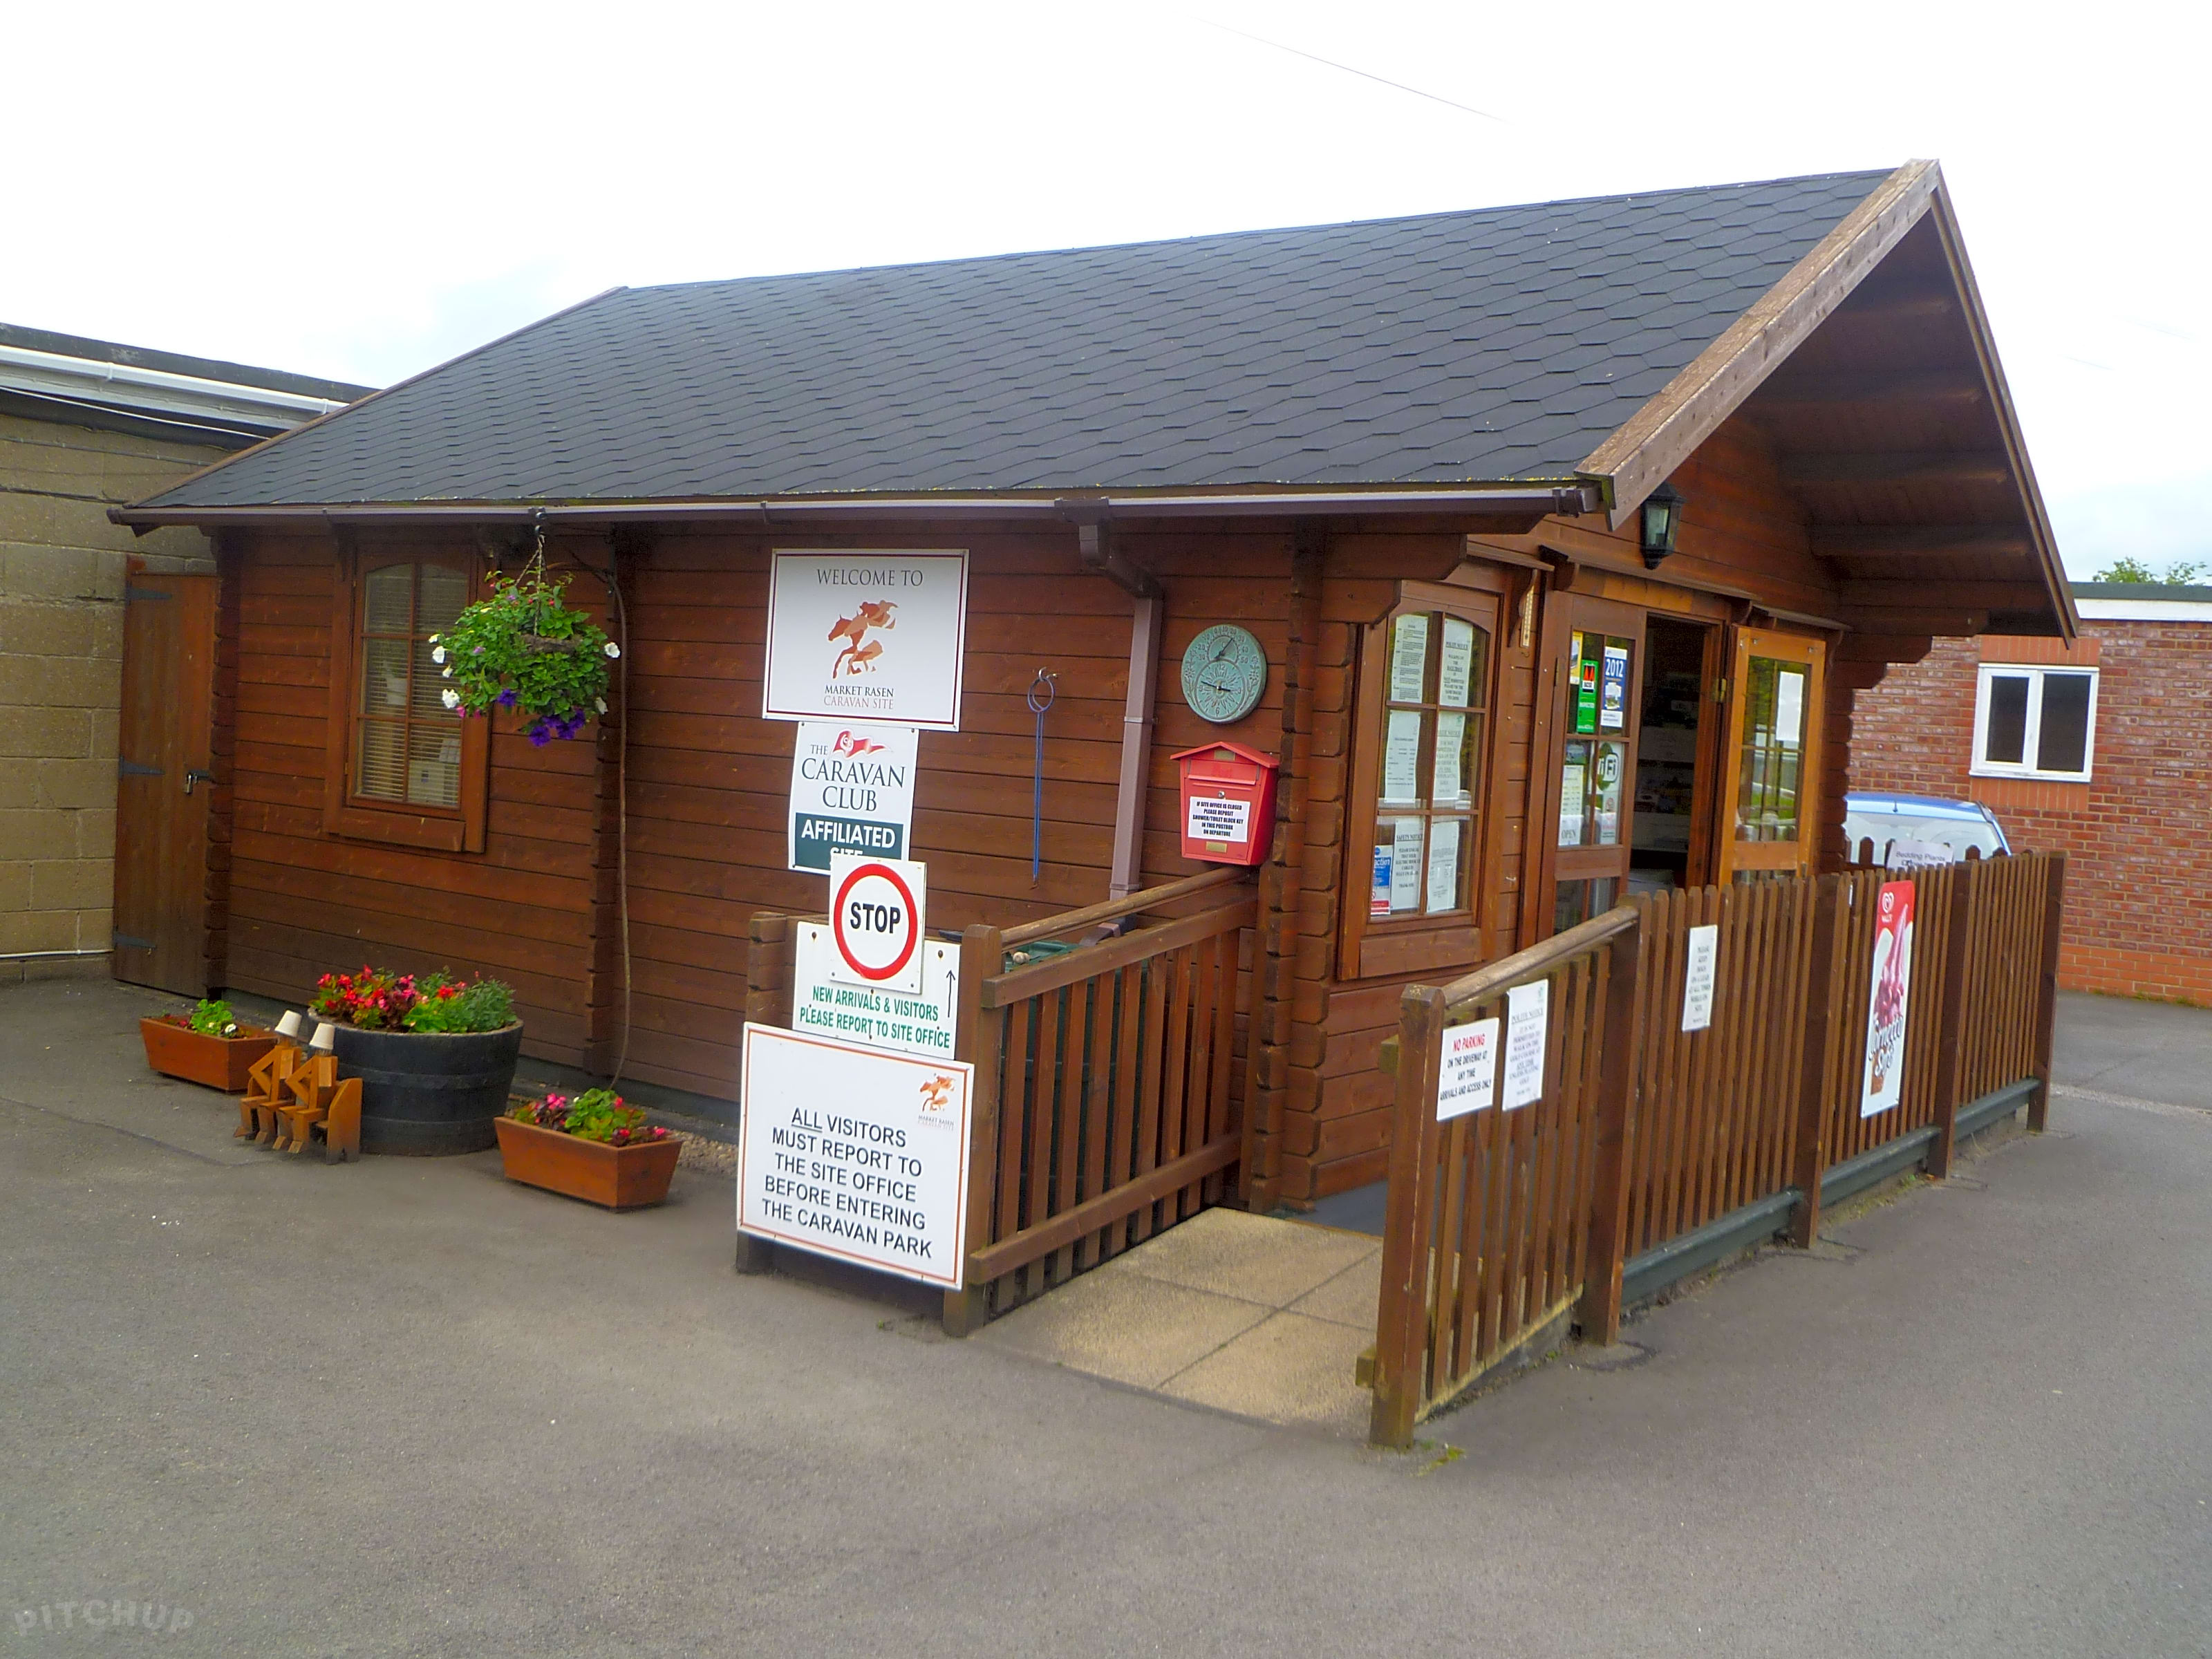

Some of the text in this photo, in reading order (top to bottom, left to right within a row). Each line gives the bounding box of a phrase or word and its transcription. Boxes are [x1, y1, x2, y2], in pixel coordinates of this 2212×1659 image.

[816, 569, 924, 587] WELCOME TO
[1605, 658, 1624, 677] 2012
[824, 685, 894, 698] MARKET RASEN
[823, 695, 894, 710] CARAVAN SITE
[810, 744, 828, 756] THE
[801, 758, 905, 789] CARAVAN
[822, 785, 877, 812] CLUB
[1192, 814, 1223, 823] SHOWER/TOILET
[801, 818, 896, 849] AFFILIATED
[1209, 829, 1231, 837] DEPARTURE
[1896, 851, 1945, 861] Bedding Plants
[850, 901, 901, 935] STOP
[813, 985, 939, 1022] NEW ARRIVALS & VISITORS
[800, 1006, 950, 1049] PLEASE REPORT TO SITE OFFICE
[1454, 1033, 1485, 1051] NO PARKING
[1447, 1059, 1453, 1069] ON
[1463, 1051, 1481, 1065] DRIVEWAY
[1483, 1050, 1488, 1060] AT
[1466, 1067, 1476, 1078] TIME
[1440, 1087, 1458, 1100] ARRIVALS
[1467, 1080, 1481, 1093] ACCESS
[791, 1107, 907, 1147] ALL VISITORS
[772, 1127, 922, 1177] MUST REPORT TO
[775, 1152, 917, 1203] THE SITE OFFICE
[765, 1174, 926, 1230] BEFORE ENTERING
[762, 1198, 932, 1259] THE CARAVAN PARK
